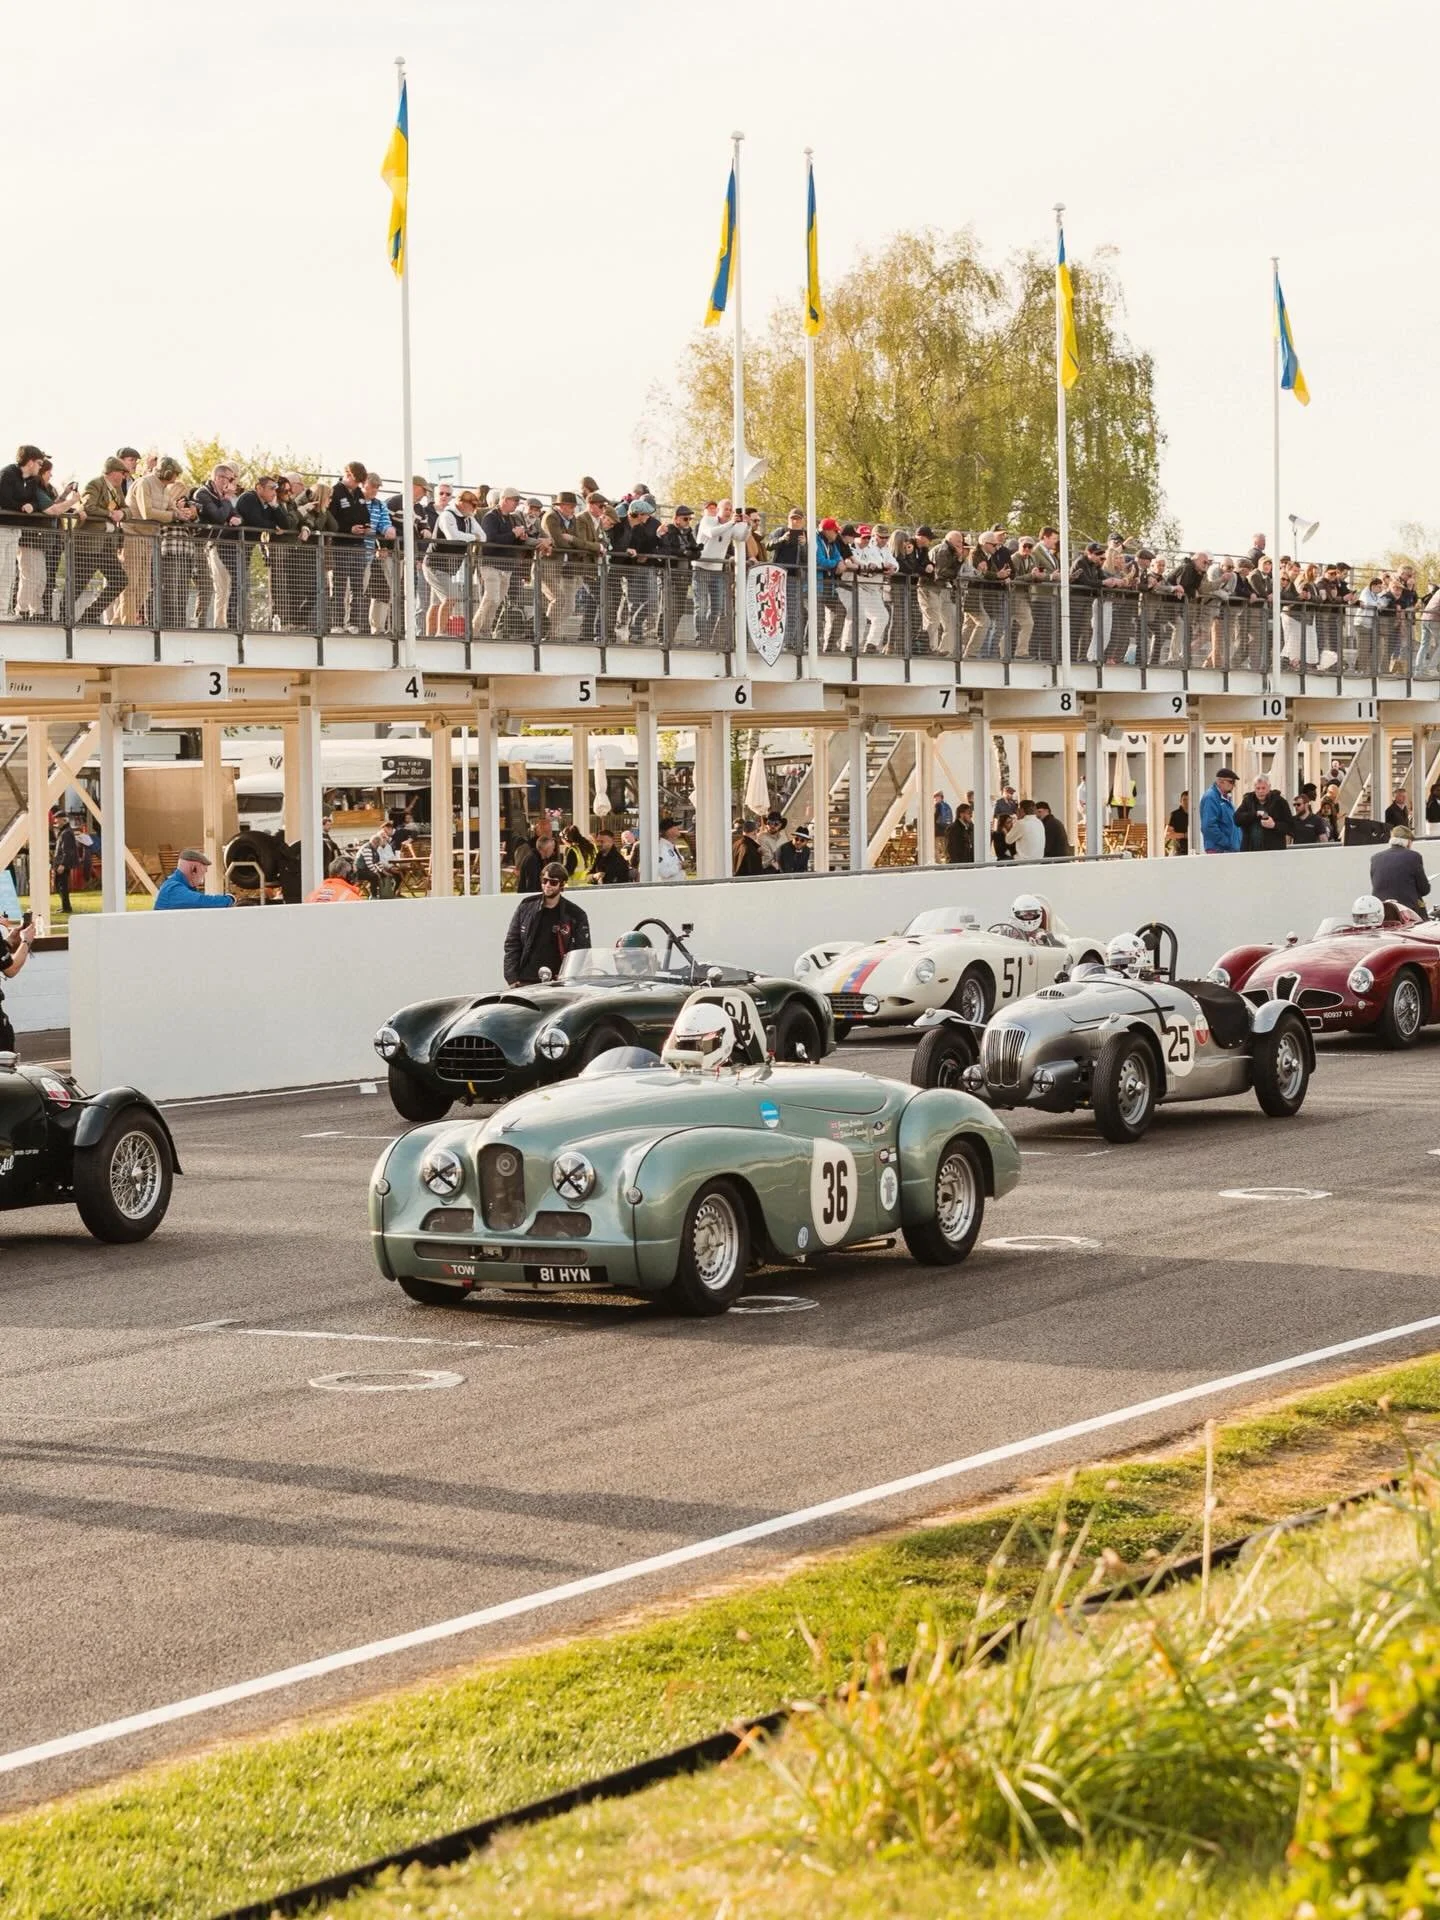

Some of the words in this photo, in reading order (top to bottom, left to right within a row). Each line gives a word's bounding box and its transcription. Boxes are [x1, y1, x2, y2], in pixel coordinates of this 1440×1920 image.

[208, 671, 222, 696] 3
[404, 676, 419, 699] 4
[578, 681, 591, 702] 5
[734, 684, 747, 704] 6
[939, 689, 951, 708] 7
[1060, 693, 1072, 711] 8
[1171, 696, 1183, 713] 9
[1263, 699, 1282, 716] 10
[1357, 702, 1373, 718] 11
[396, 767, 410, 776] The
[410, 766, 424, 776] Bar
[1002, 956, 1022, 998] 51
[1167, 1025, 1190, 1062] 25
[822, 1160, 848, 1224] 36
[451, 1264, 475, 1275] TOW
[540, 1267, 554, 1282] 81
[560, 1267, 591, 1282] HYN
